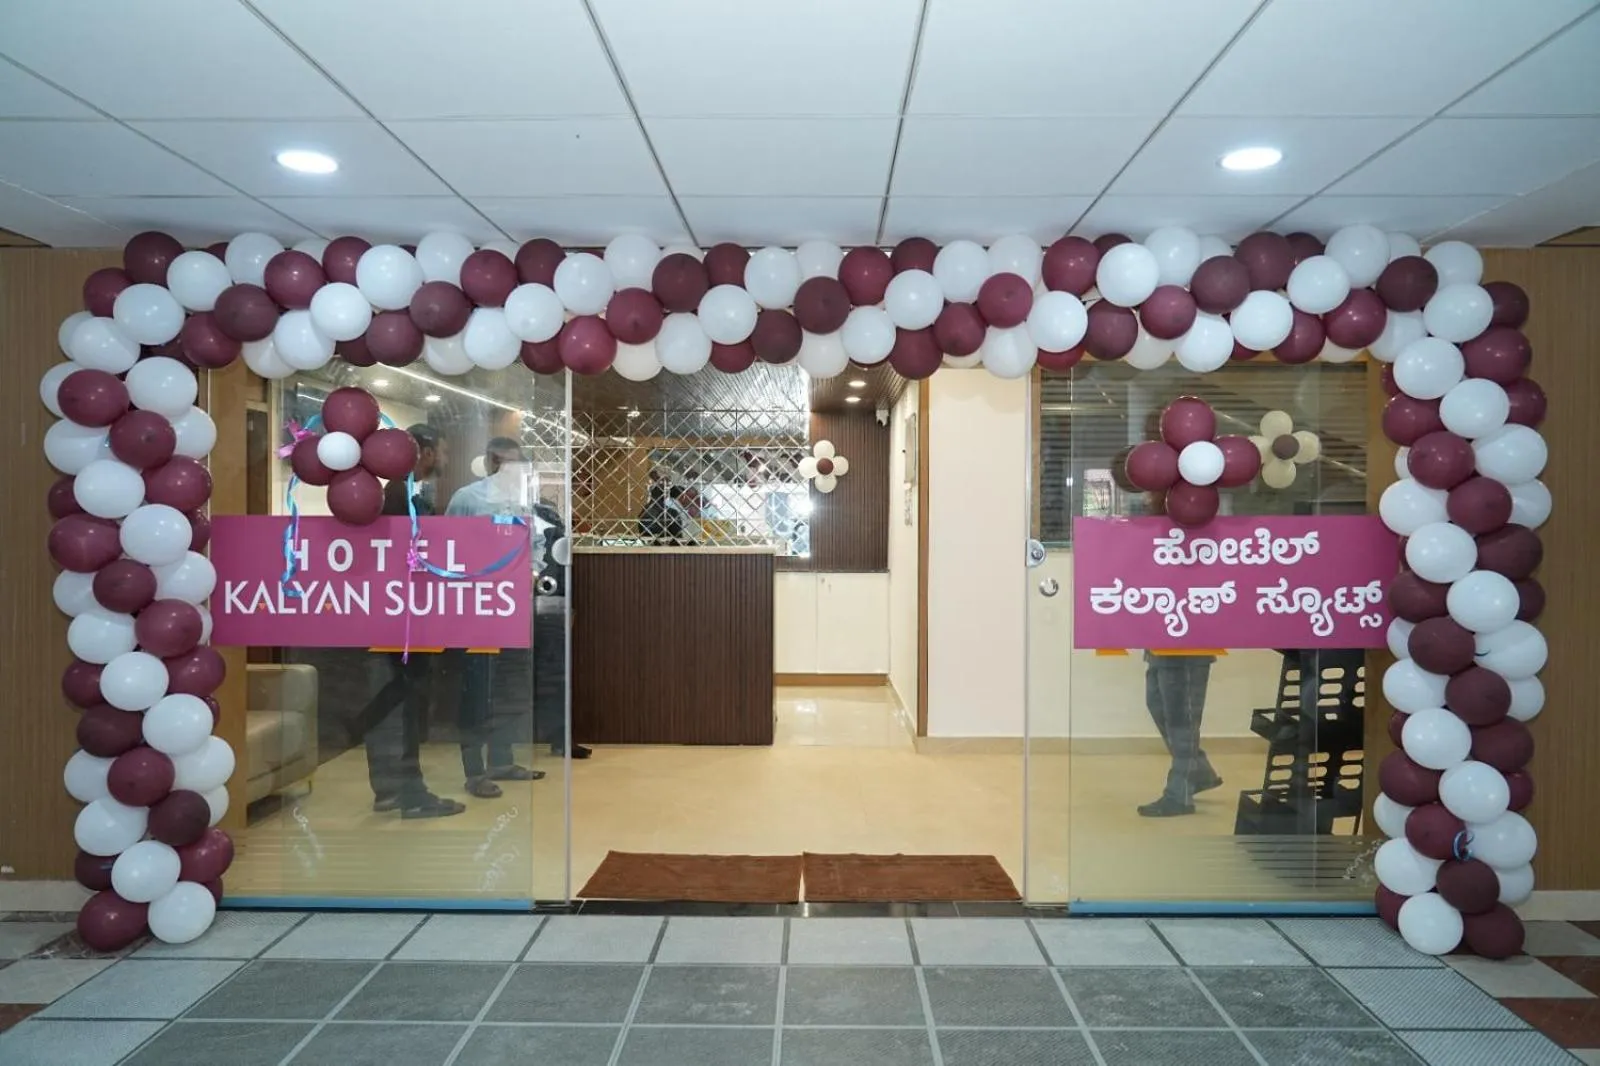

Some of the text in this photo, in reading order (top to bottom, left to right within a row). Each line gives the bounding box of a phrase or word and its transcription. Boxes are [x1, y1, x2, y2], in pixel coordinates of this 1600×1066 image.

[1153, 527, 1320, 566] ಹೋಟೆಲ್
[224, 580, 516, 617] KALYAN SUITES
[1089, 576, 1383, 638] ಕಲ್ಯಾಣ್ ಸ್ಯೂಟ್ಸ್
